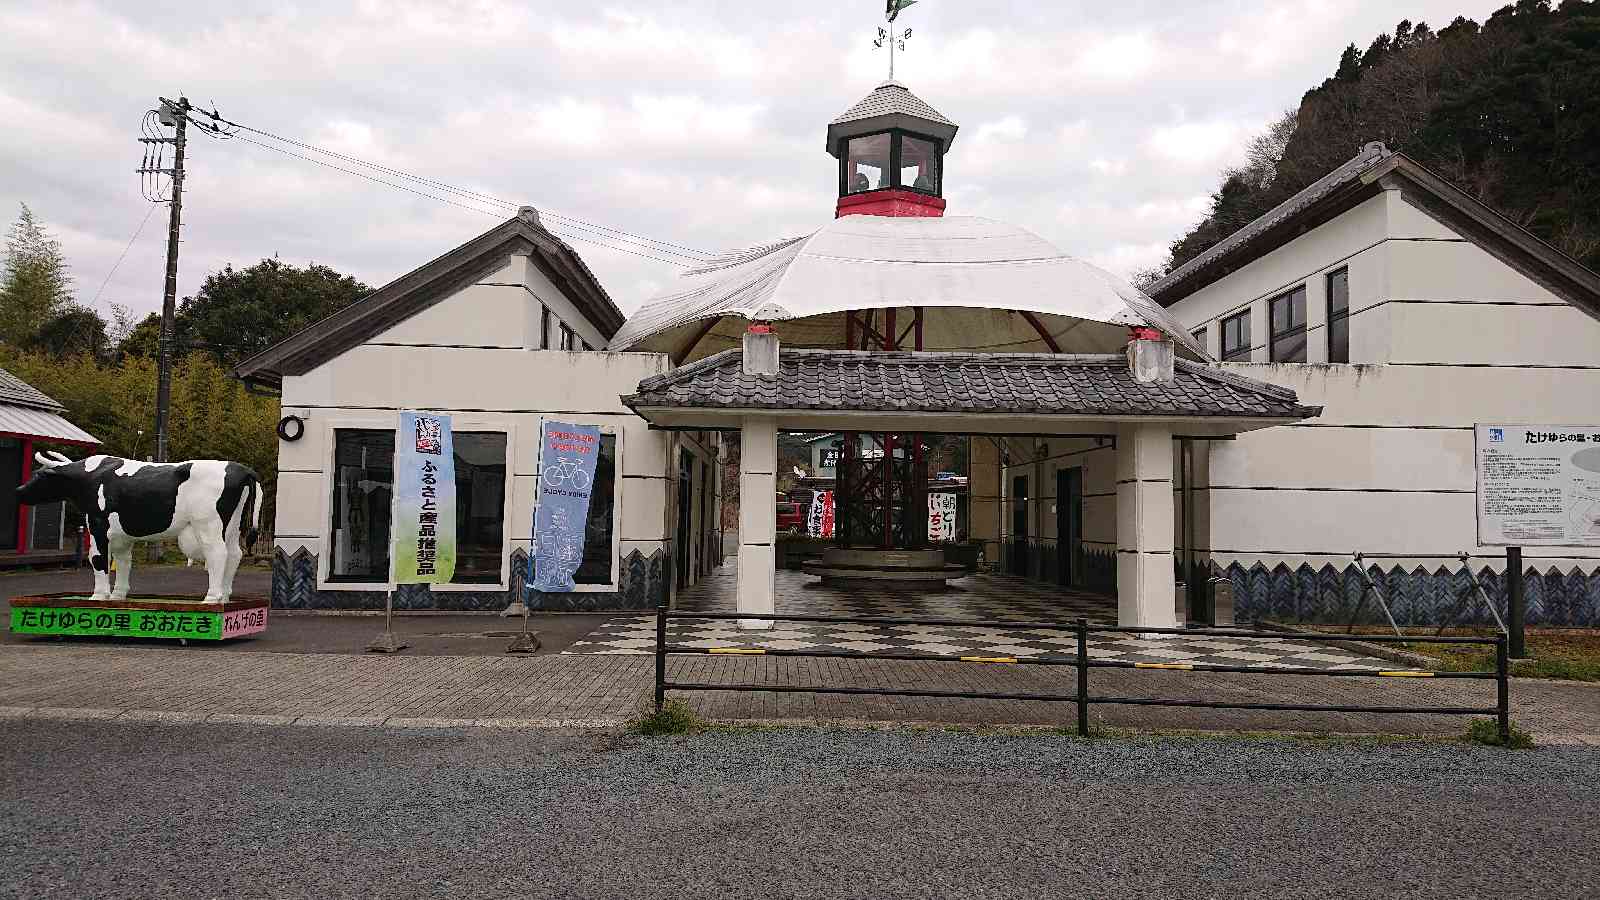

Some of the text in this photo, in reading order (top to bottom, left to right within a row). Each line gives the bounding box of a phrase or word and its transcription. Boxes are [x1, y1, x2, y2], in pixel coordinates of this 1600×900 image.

[416, 460, 438, 576] ふるさと産品推奨品
[20, 610, 213, 634] たけゆらの里 おおたき
